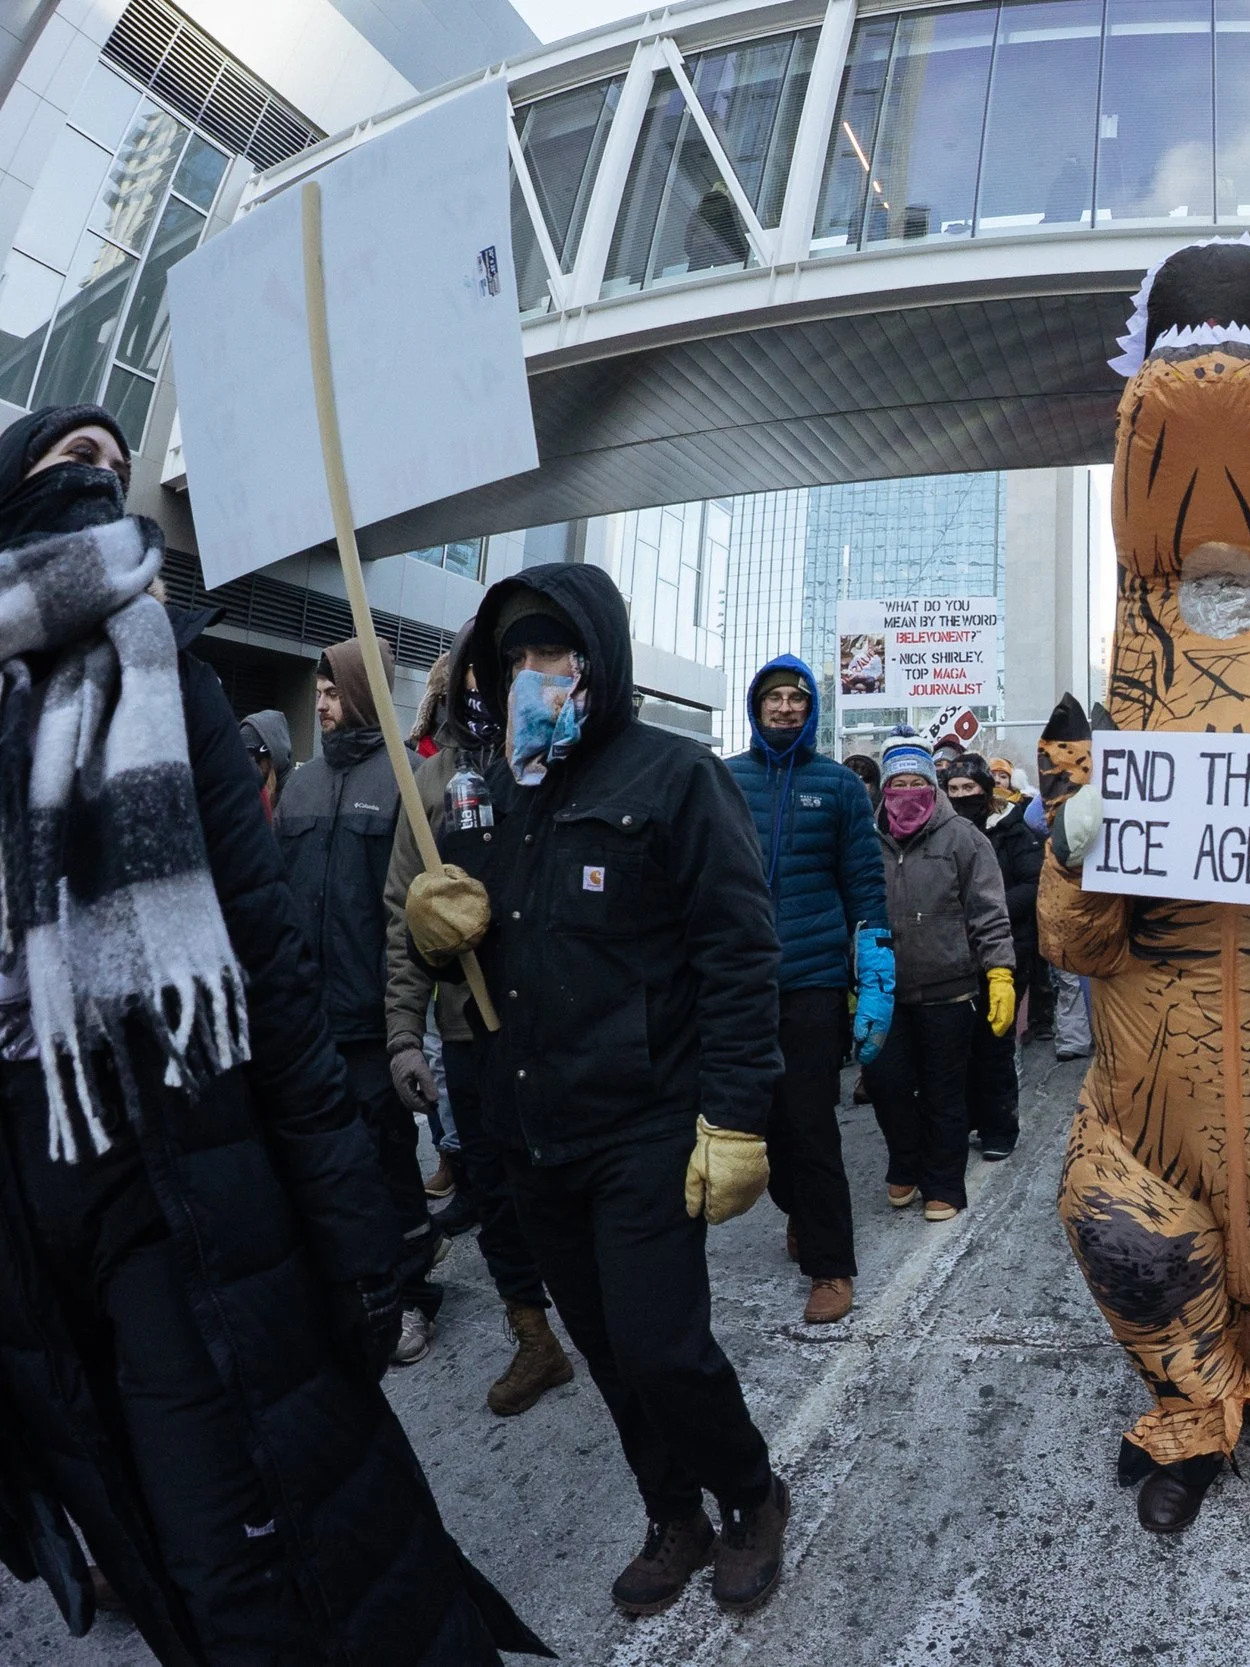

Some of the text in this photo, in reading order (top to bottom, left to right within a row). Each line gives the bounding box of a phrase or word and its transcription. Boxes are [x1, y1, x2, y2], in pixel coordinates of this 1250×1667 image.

[924, 599, 941, 612] DO
[945, 599, 970, 612] YOU
[884, 614, 997, 629] MEAN BY THE WORD
[899, 653, 927, 665] NICK
[933, 667, 967, 680] MAGA
[1101, 748, 1175, 803] END
[1095, 817, 1170, 877] ICE
